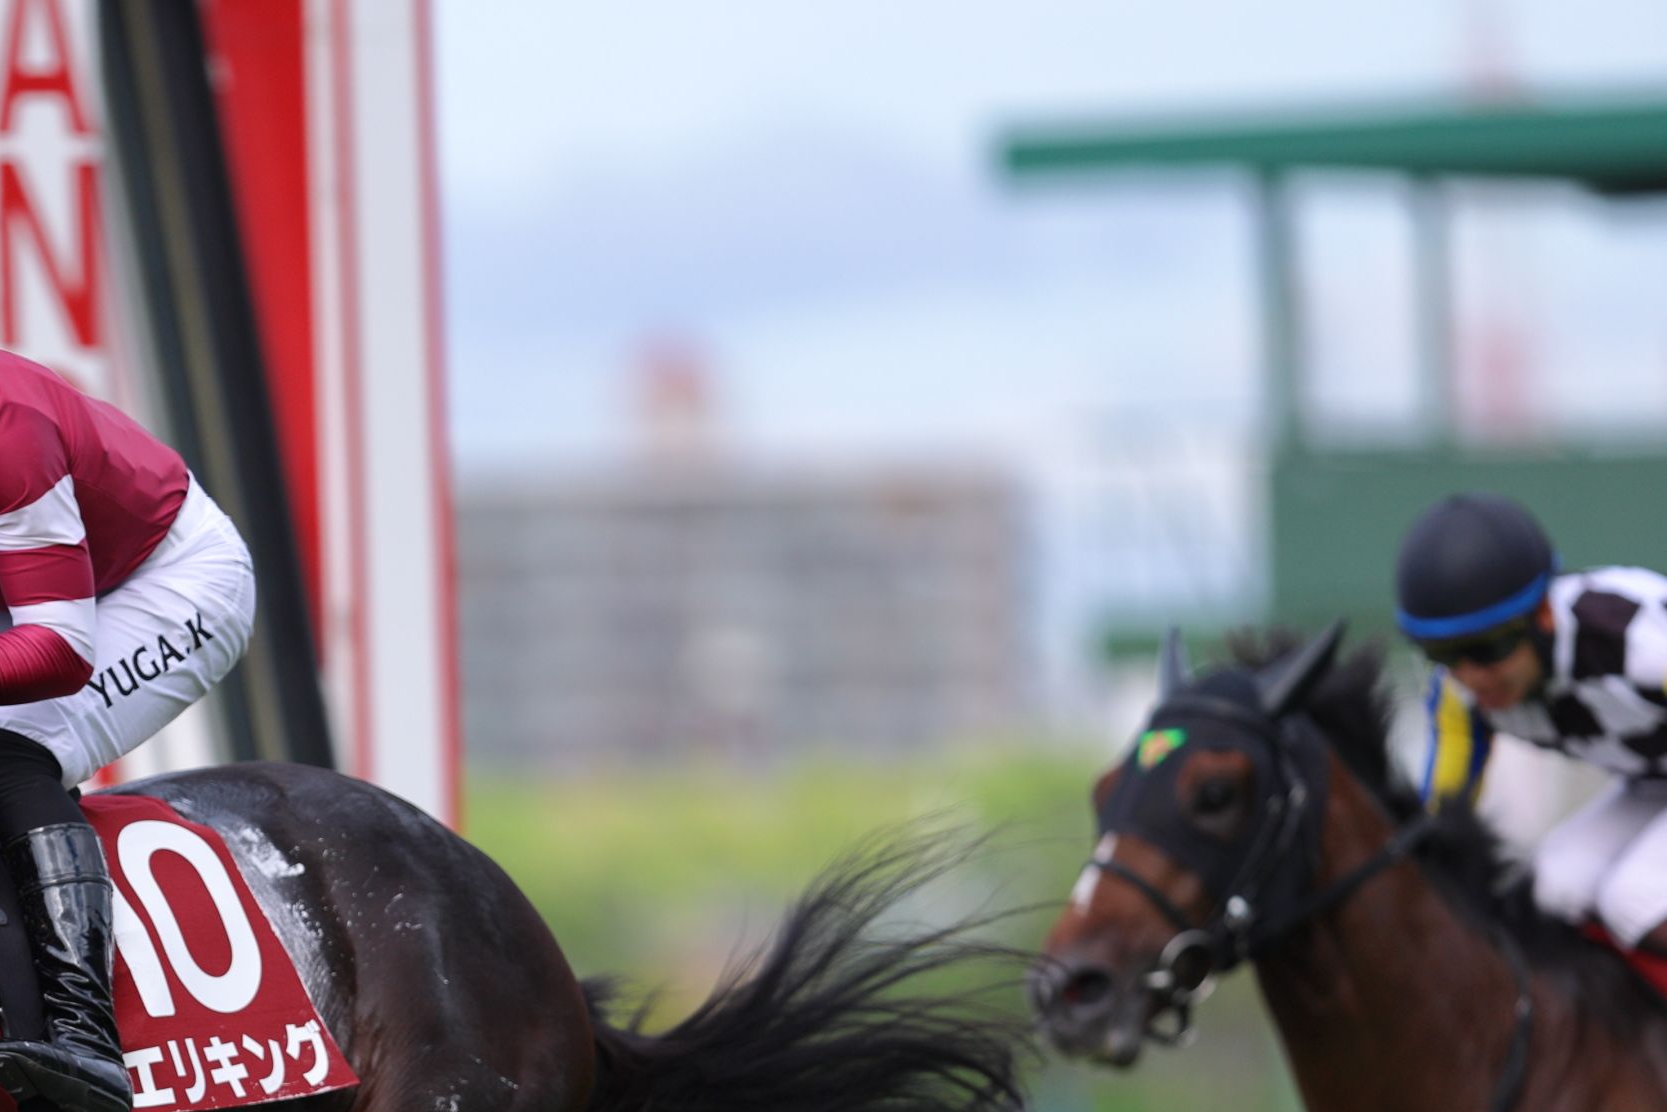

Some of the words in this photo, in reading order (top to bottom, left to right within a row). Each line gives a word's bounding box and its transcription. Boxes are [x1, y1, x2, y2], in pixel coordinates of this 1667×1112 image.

[86, 612, 213, 708] YUGA.K
[112, 819, 262, 1018] 10
[122, 1018, 330, 1108] エリキング
